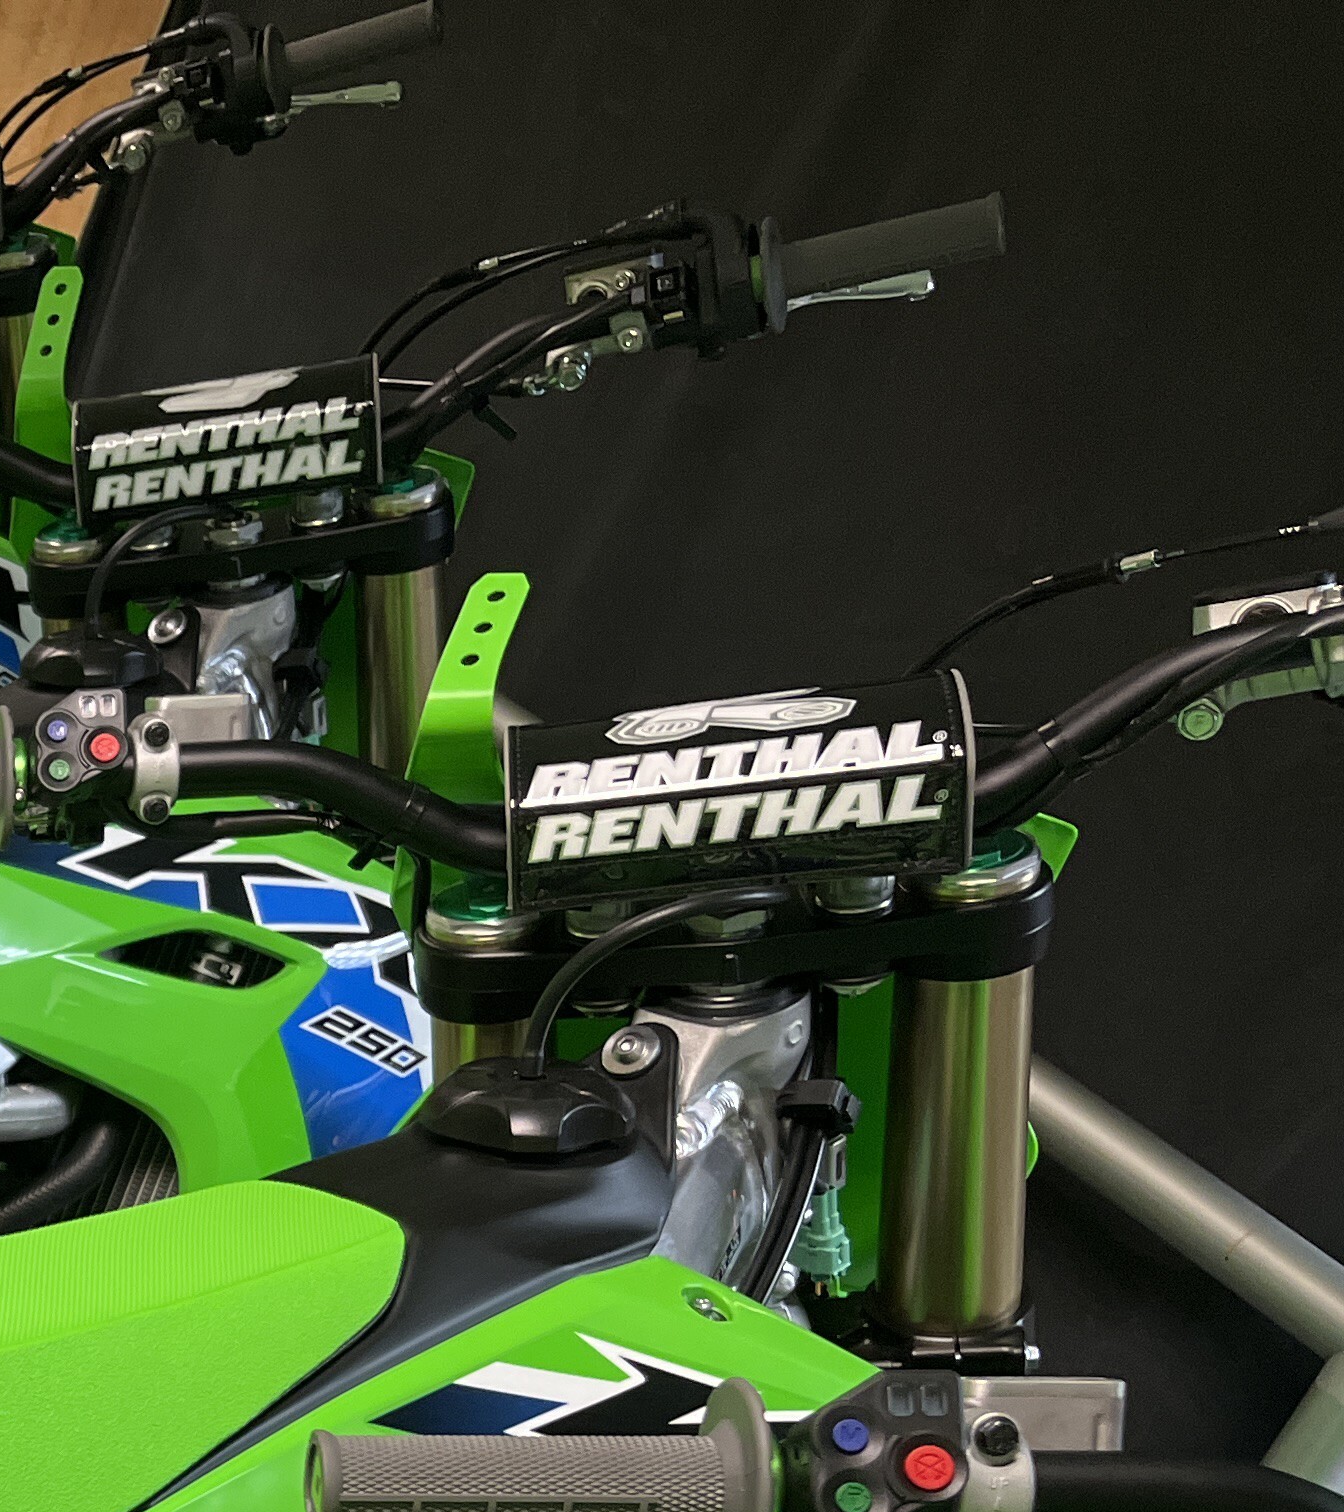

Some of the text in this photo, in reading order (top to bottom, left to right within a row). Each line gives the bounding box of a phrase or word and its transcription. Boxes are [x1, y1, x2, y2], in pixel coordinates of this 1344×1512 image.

[88, 397, 360, 470] RENTHAL
[92, 439, 362, 512] RENTHAL
[521, 720, 944, 807] RENTHAL
[526, 774, 943, 863] RENTHAL
[306, 1008, 427, 1075] 250
